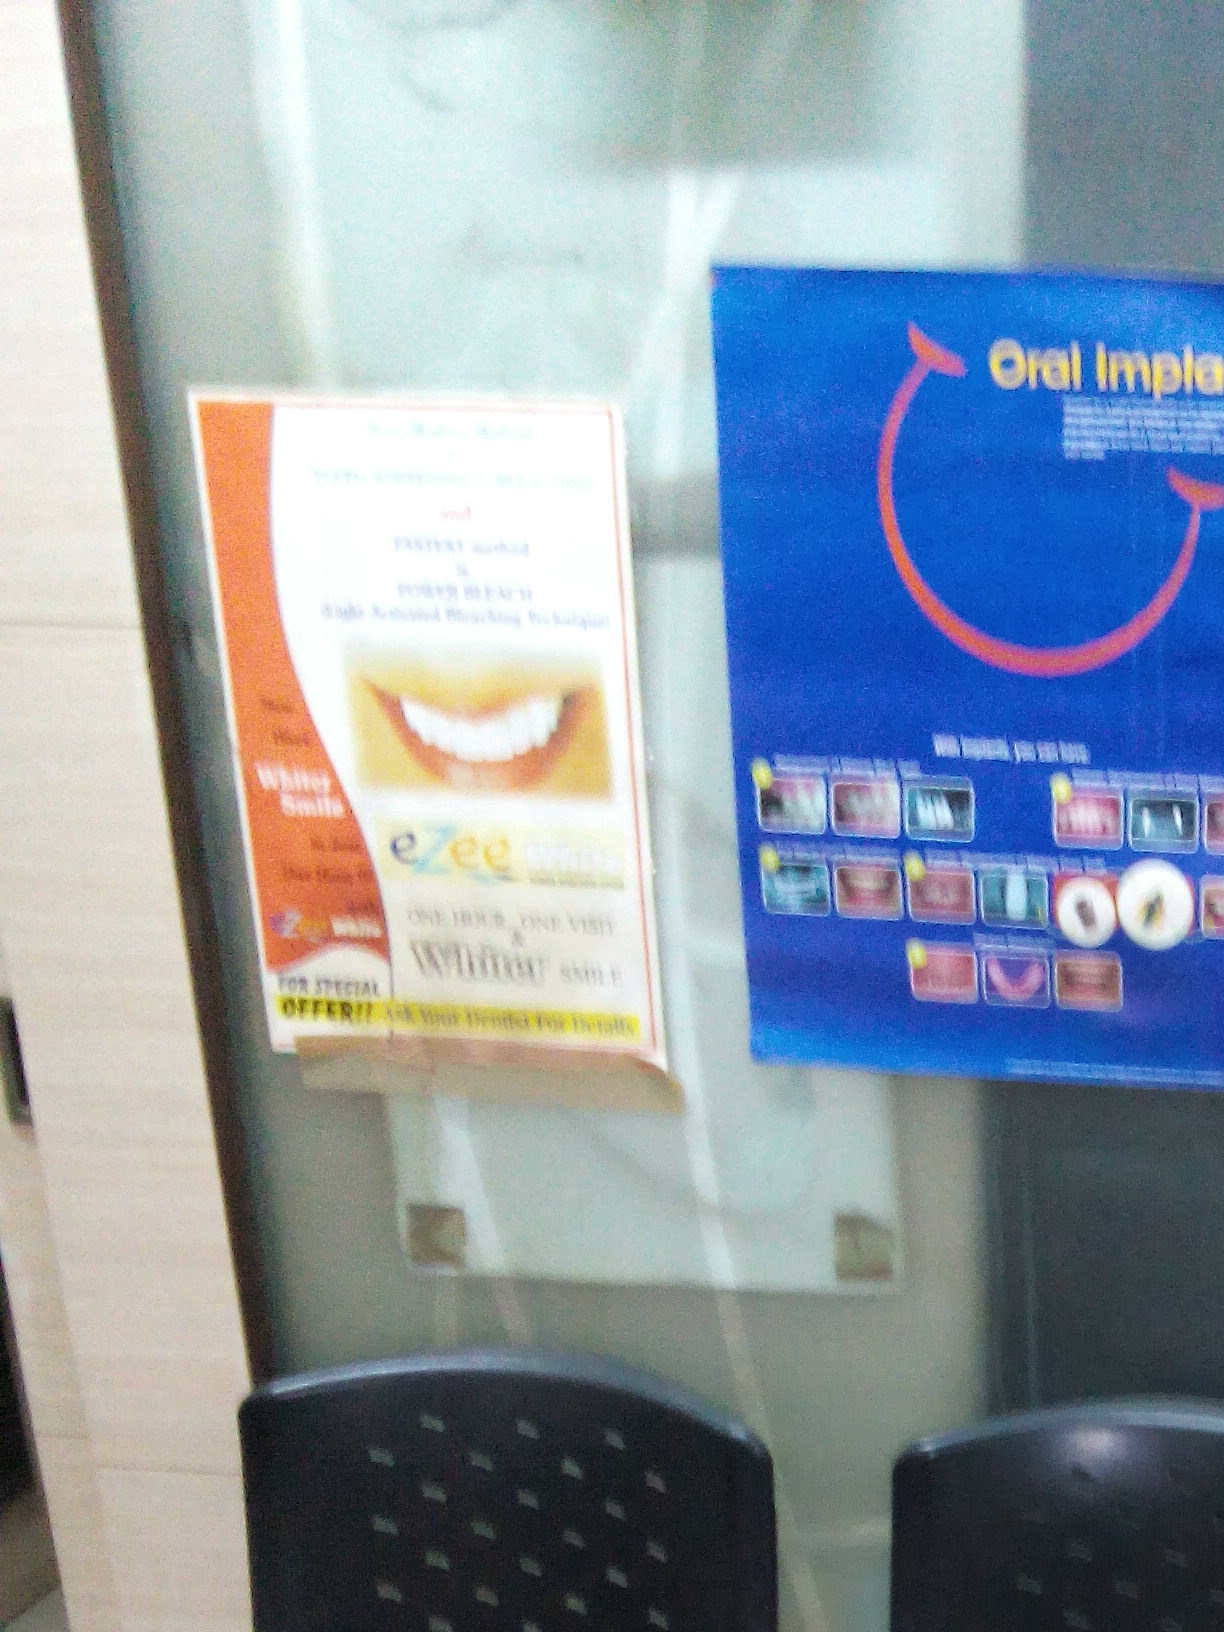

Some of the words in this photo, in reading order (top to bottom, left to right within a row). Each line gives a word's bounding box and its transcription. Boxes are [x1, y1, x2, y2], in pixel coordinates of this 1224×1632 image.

[988, 338, 1081, 391] Oral
[280, 792, 345, 818] Smile
[560, 962, 624, 985] SMILE
[279, 976, 308, 994] FOR
[315, 978, 380, 997] SPECIAL
